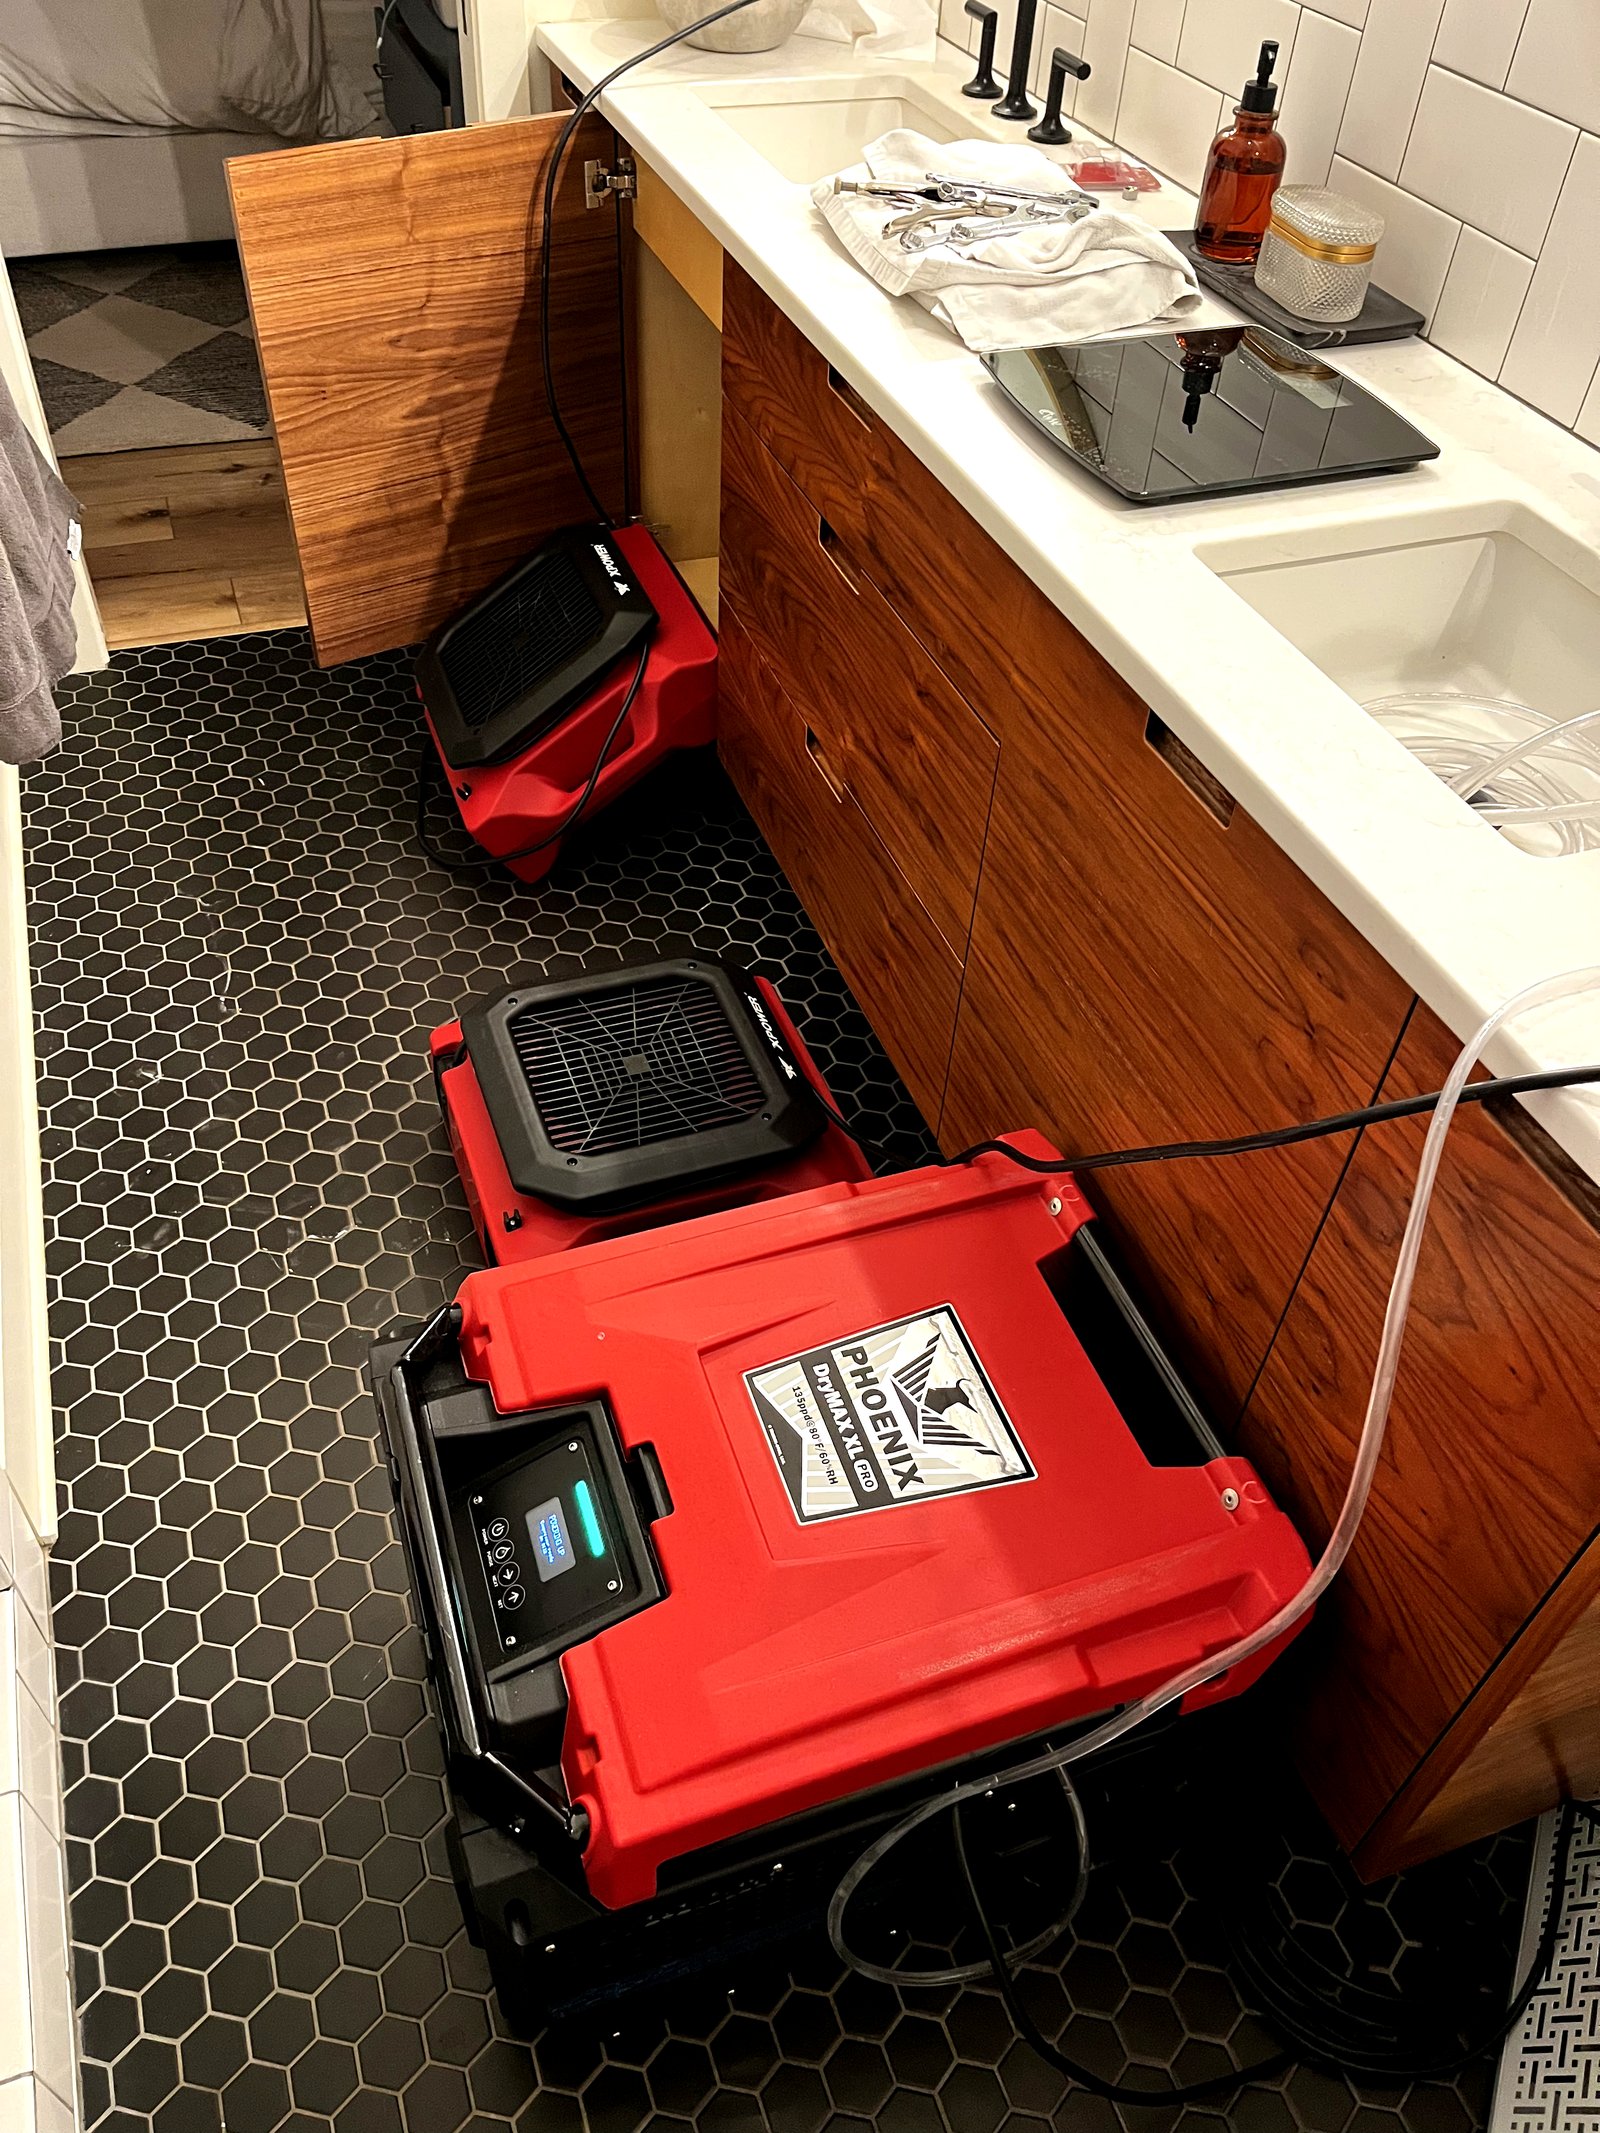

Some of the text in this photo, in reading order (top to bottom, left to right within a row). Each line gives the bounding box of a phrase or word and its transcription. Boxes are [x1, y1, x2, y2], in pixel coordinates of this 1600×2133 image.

[593, 543, 622, 578] XPOWER
[747, 995, 784, 1052] XPOWER
[811, 1362, 875, 1489] DryMAX XL PRO
[840, 1345, 924, 1491] PHOENIX
